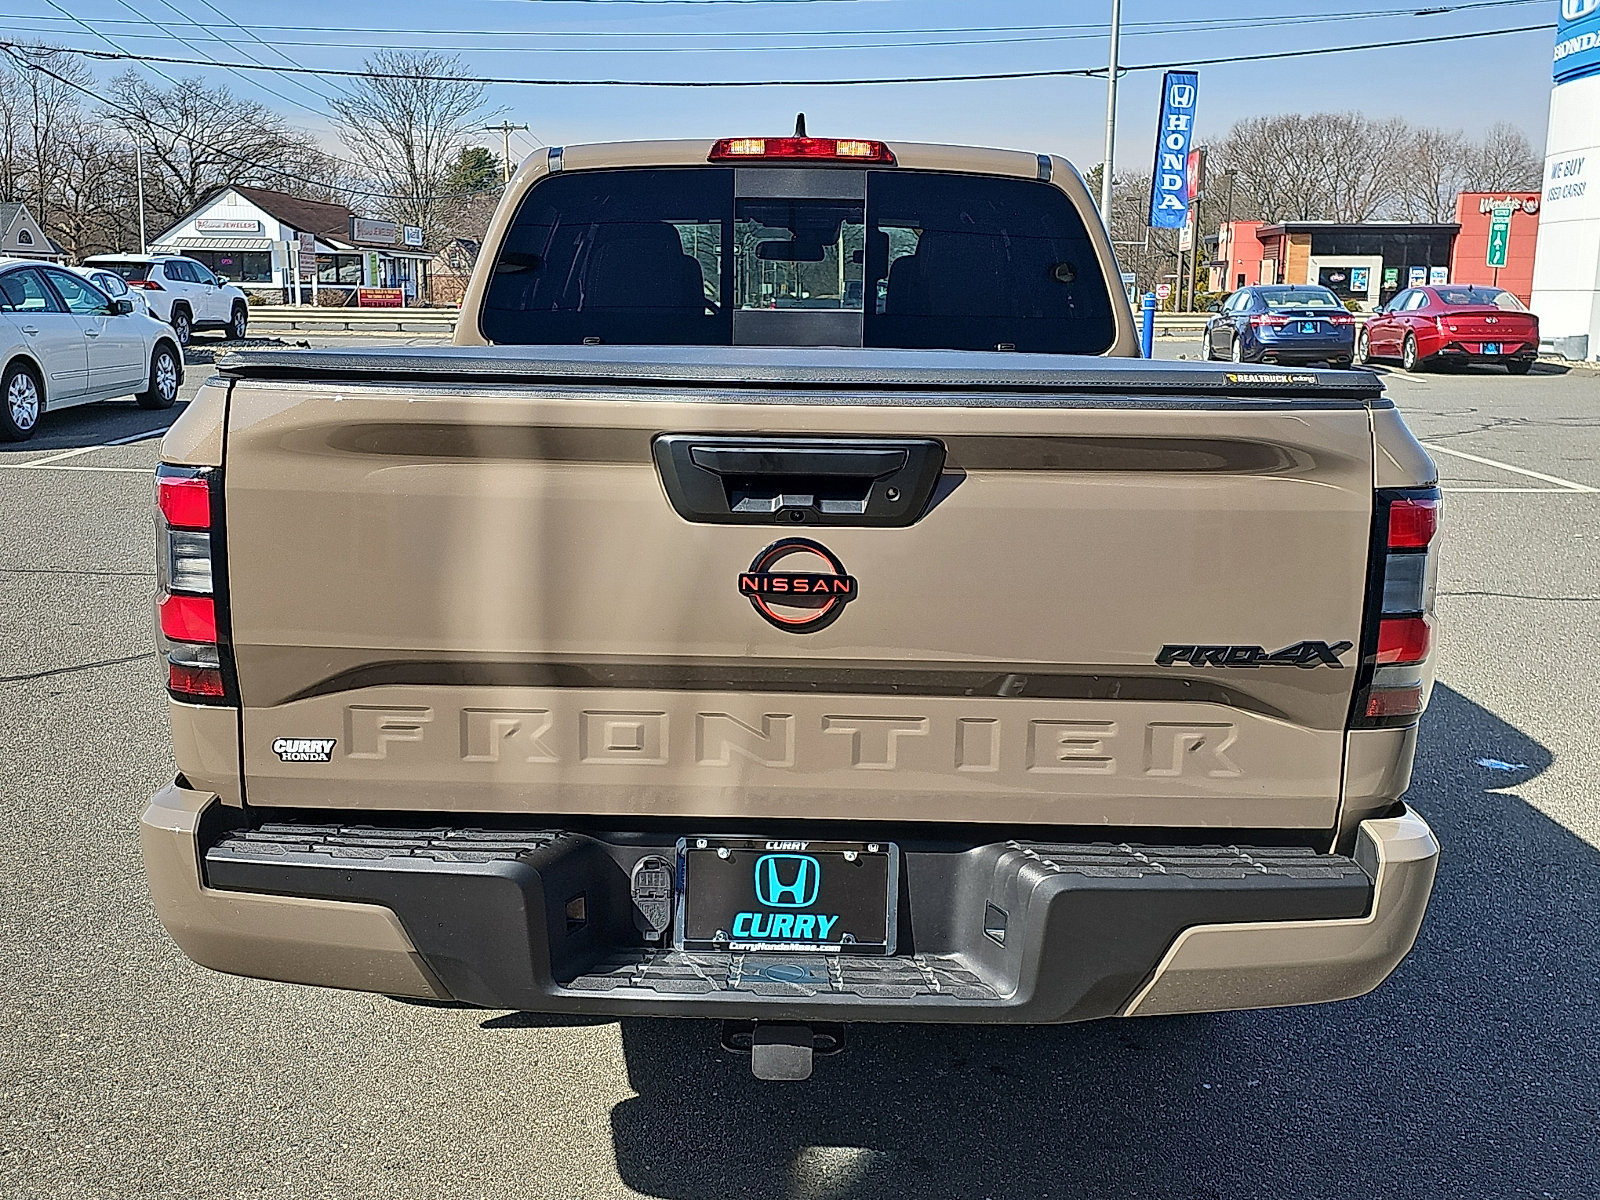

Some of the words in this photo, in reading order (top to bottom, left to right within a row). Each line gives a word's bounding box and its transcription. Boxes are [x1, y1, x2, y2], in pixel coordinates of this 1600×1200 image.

[1158, 114, 1191, 210] HONDA
[1551, 162, 1563, 180] WE
[1564, 157, 1586, 178] BUY
[1479, 195, 1522, 213] Wendy's
[1237, 374, 1288, 383] REALTRUCK
[742, 576, 850, 593] NISSAN
[1154, 640, 1354, 669] PRO-4X
[273, 739, 335, 753] CURRY
[343, 704, 1243, 778] FRONTIER
[282, 752, 328, 761] HONDA
[765, 840, 809, 850] CURRY
[732, 912, 840, 939] CURRY
[728, 942, 842, 953] CurryHondaMass.com
